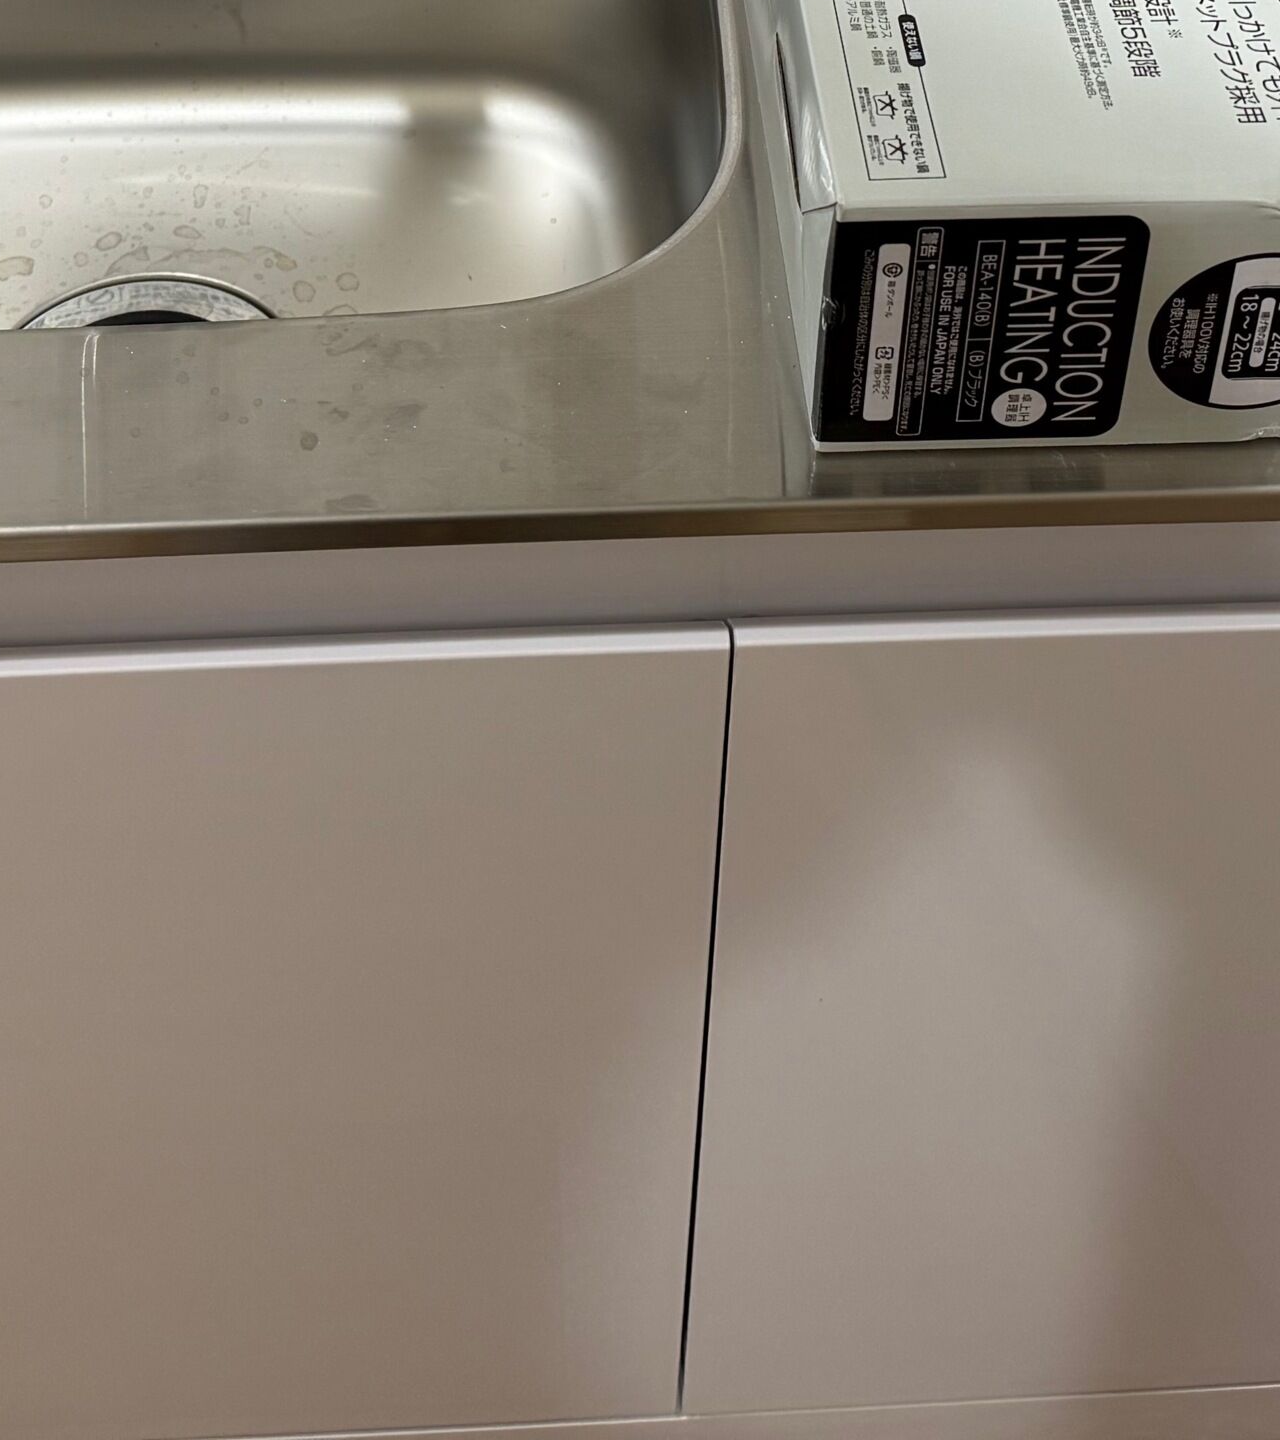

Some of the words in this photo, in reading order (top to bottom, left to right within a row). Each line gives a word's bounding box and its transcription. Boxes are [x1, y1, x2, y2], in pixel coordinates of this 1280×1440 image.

[918, 231, 939, 258] 警告
[940, 264, 956, 287] FOR
[971, 253, 998, 327] BEA-140(B)
[937, 289, 953, 312] USE
[997, 238, 1066, 384] HEATING
[936, 314, 950, 326] IN
[1049, 236, 1127, 421] INDUCTION
[1158, 297, 1185, 369] お使いください。
[1177, 308, 1200, 359] 調理器具を
[932, 327, 948, 365] JAPAN
[928, 366, 944, 394] ONLY
[1003, 393, 1019, 422] 調理器
[1016, 393, 1033, 422] 卓上IH
